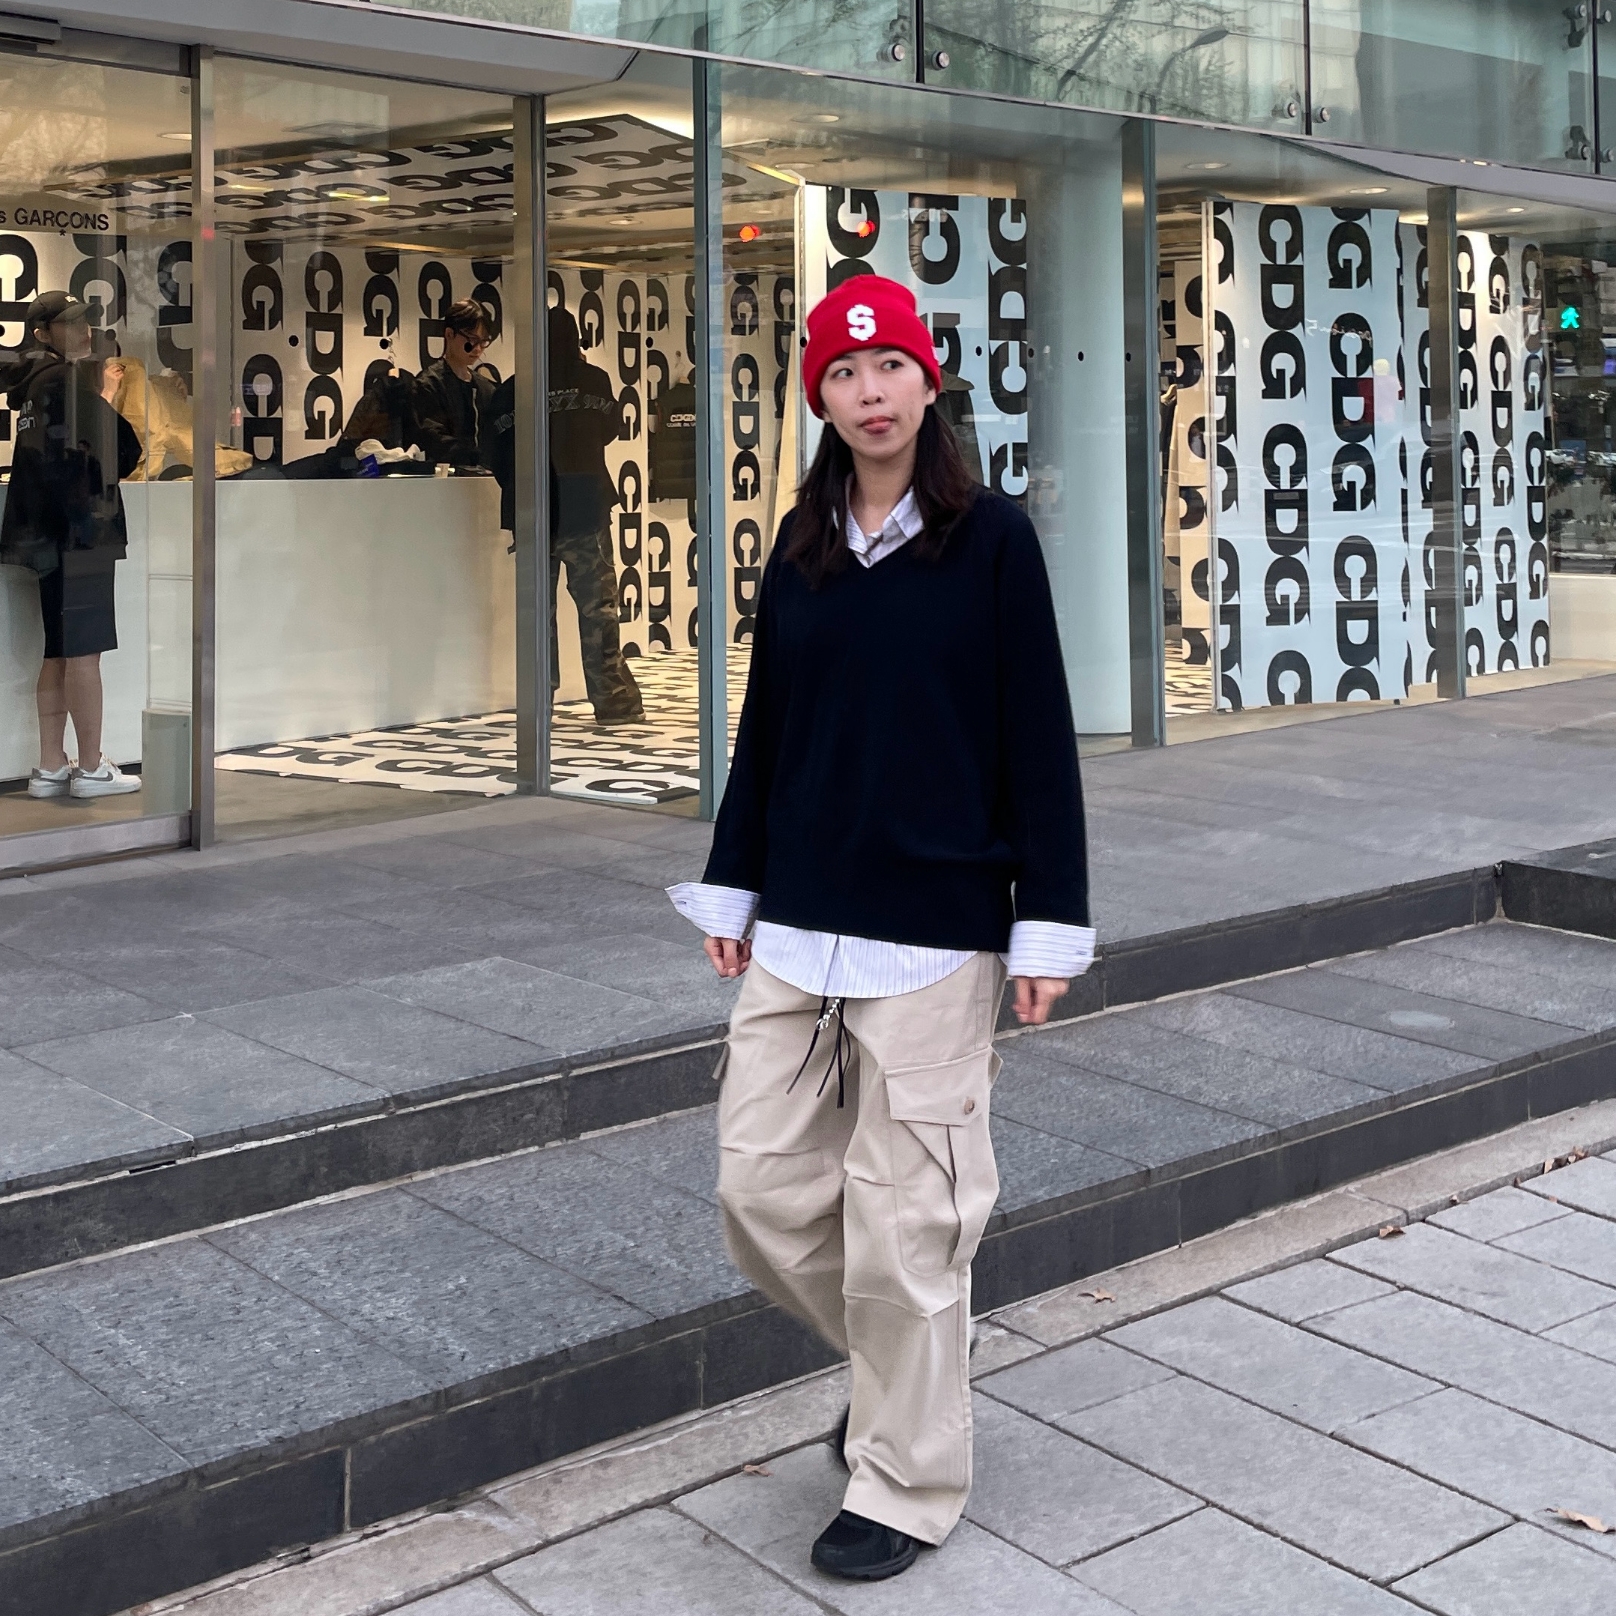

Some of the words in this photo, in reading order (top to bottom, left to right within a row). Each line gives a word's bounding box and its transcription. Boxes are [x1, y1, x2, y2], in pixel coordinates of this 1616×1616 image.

[299, 251, 343, 440] CDG
[617, 279, 642, 441] CDG
[847, 304, 877, 341] S
[1259, 204, 1306, 401] CDG
[1457, 235, 1478, 411] CDG
[1521, 244, 1547, 411] CDG
[731, 353, 761, 502] CDG
[1330, 312, 1376, 514] CDG
[1490, 335, 1516, 507] CDG
[618, 460, 643, 624] CDG
[1262, 423, 1311, 627] CDG
[1460, 431, 1484, 607] CDG
[1526, 431, 1549, 601] CDG
